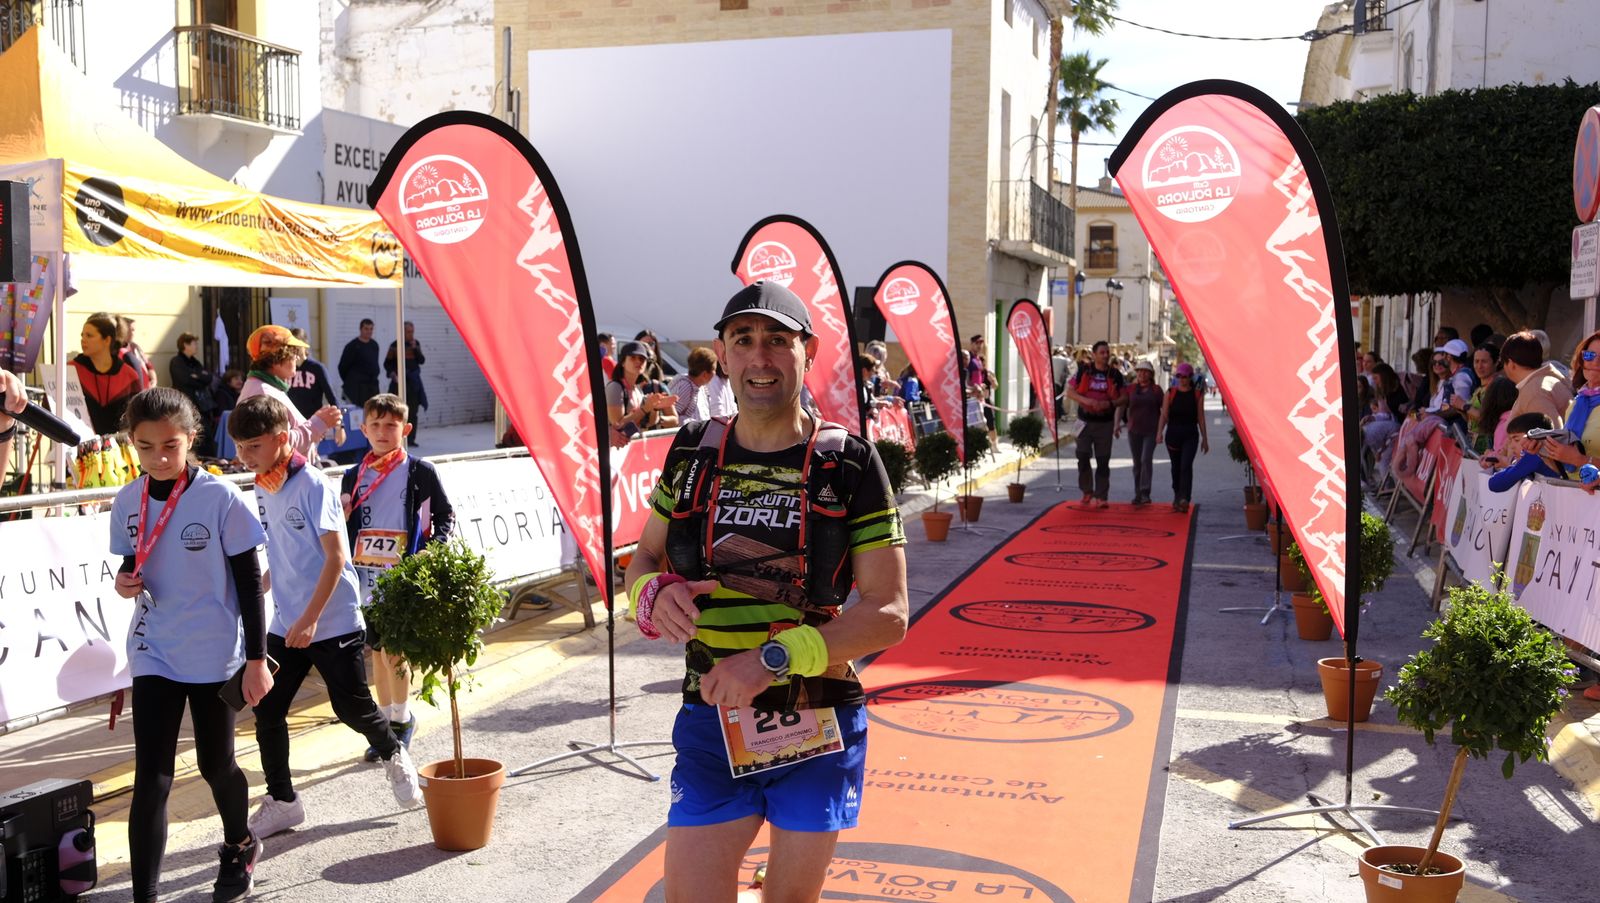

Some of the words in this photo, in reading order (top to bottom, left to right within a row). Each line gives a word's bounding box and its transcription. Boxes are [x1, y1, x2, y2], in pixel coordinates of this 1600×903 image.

[336, 180, 368, 205] AYU
[683, 458, 700, 500] AONIJIE
[364, 538, 397, 552] 747
[939, 650, 1113, 666] Ayuntamiento
[959, 645, 1062, 656] Cantoria
[903, 687, 1049, 705] POLVORA
[1061, 698, 1100, 707] LA
[750, 734, 783, 747] FRANCISCO
[1014, 777, 1048, 791] de
[974, 881, 1035, 900] LA
